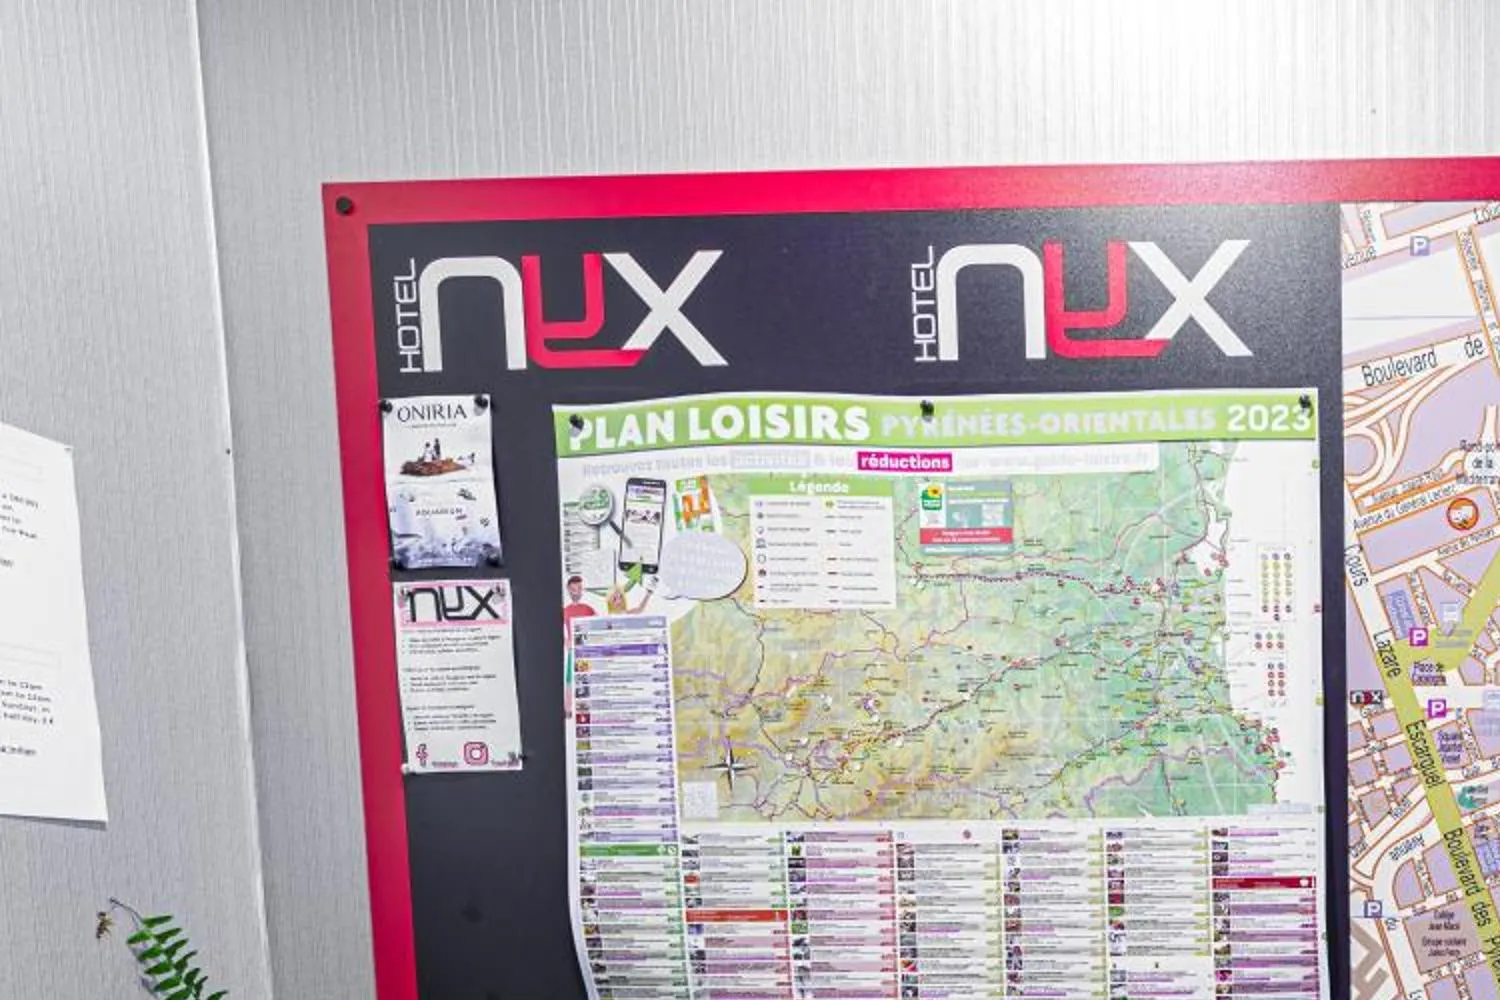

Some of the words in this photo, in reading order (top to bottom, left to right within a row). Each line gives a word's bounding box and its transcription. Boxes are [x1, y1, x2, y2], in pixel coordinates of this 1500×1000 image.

[394, 259, 422, 373] HOTEL
[912, 245, 937, 362] HOTEL
[1361, 351, 1439, 387] Boulevard
[1463, 334, 1483, 359] de
[397, 403, 467, 422] ONIRIA
[568, 413, 675, 451] PLAN
[689, 405, 870, 442] LOISIRS
[1227, 404, 1311, 433] 2023
[789, 481, 850, 496] Légende
[859, 454, 950, 470] réductions
[1405, 720, 1444, 789] Escarguel
[1444, 827, 1485, 897] Boulevard
[1471, 901, 1491, 928] des
